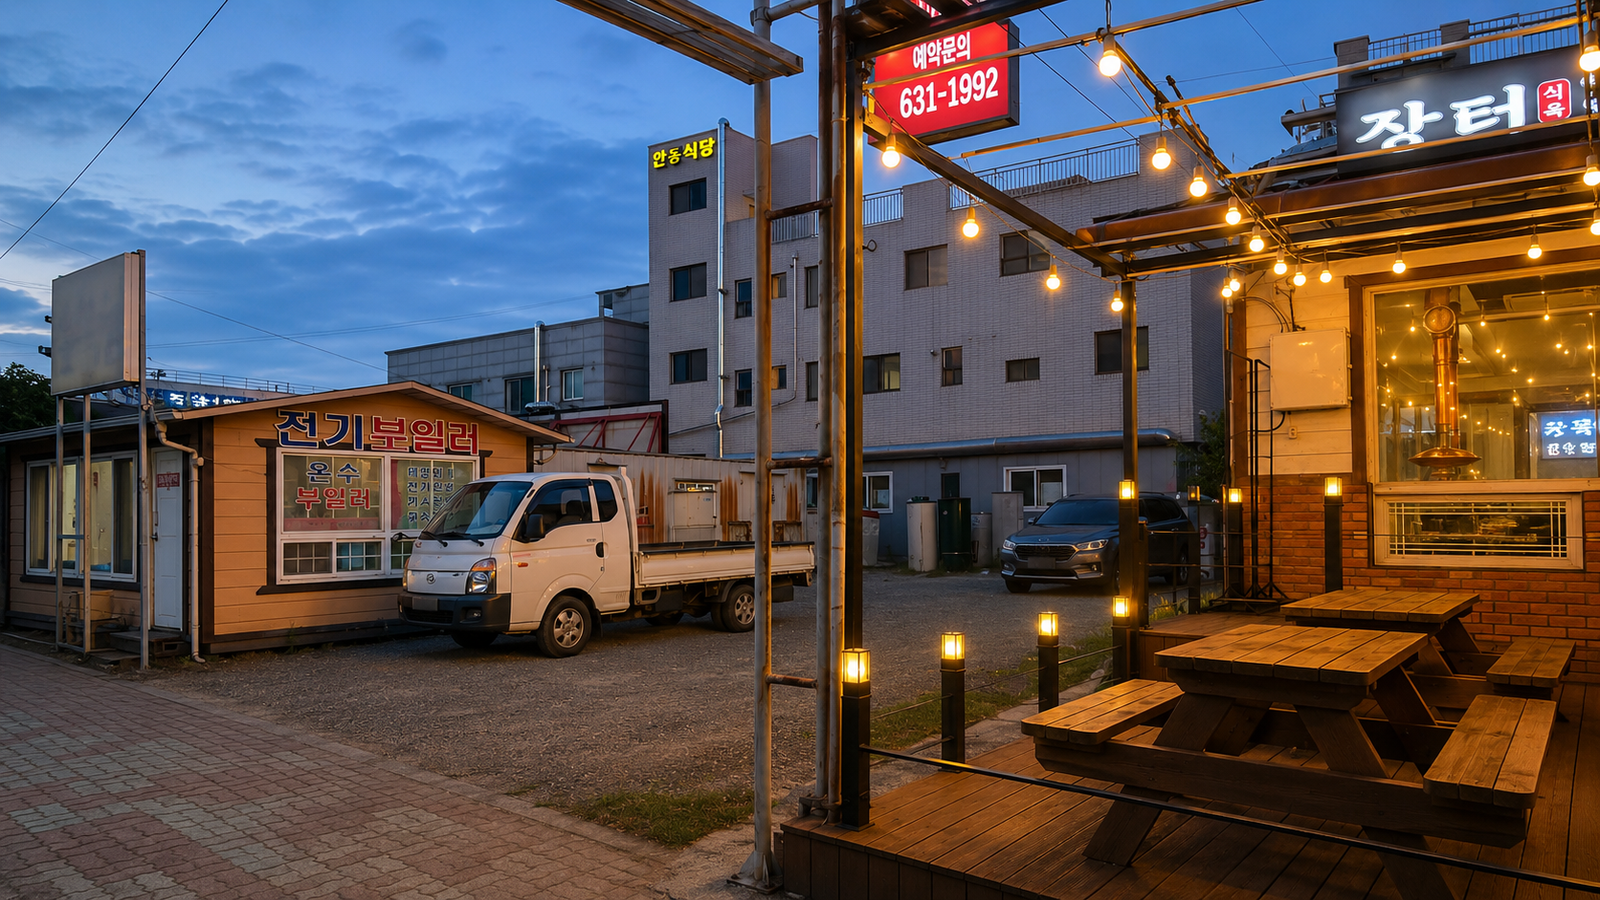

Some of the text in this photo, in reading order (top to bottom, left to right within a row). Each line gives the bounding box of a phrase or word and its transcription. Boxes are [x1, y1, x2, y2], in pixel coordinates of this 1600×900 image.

[912, 31, 971, 70] 예약문의
[900, 66, 999, 118] 631-1992
[1355, 83, 1526, 153] 장터
[652, 136, 716, 169] 안동식당
[306, 461, 361, 484] 온수
